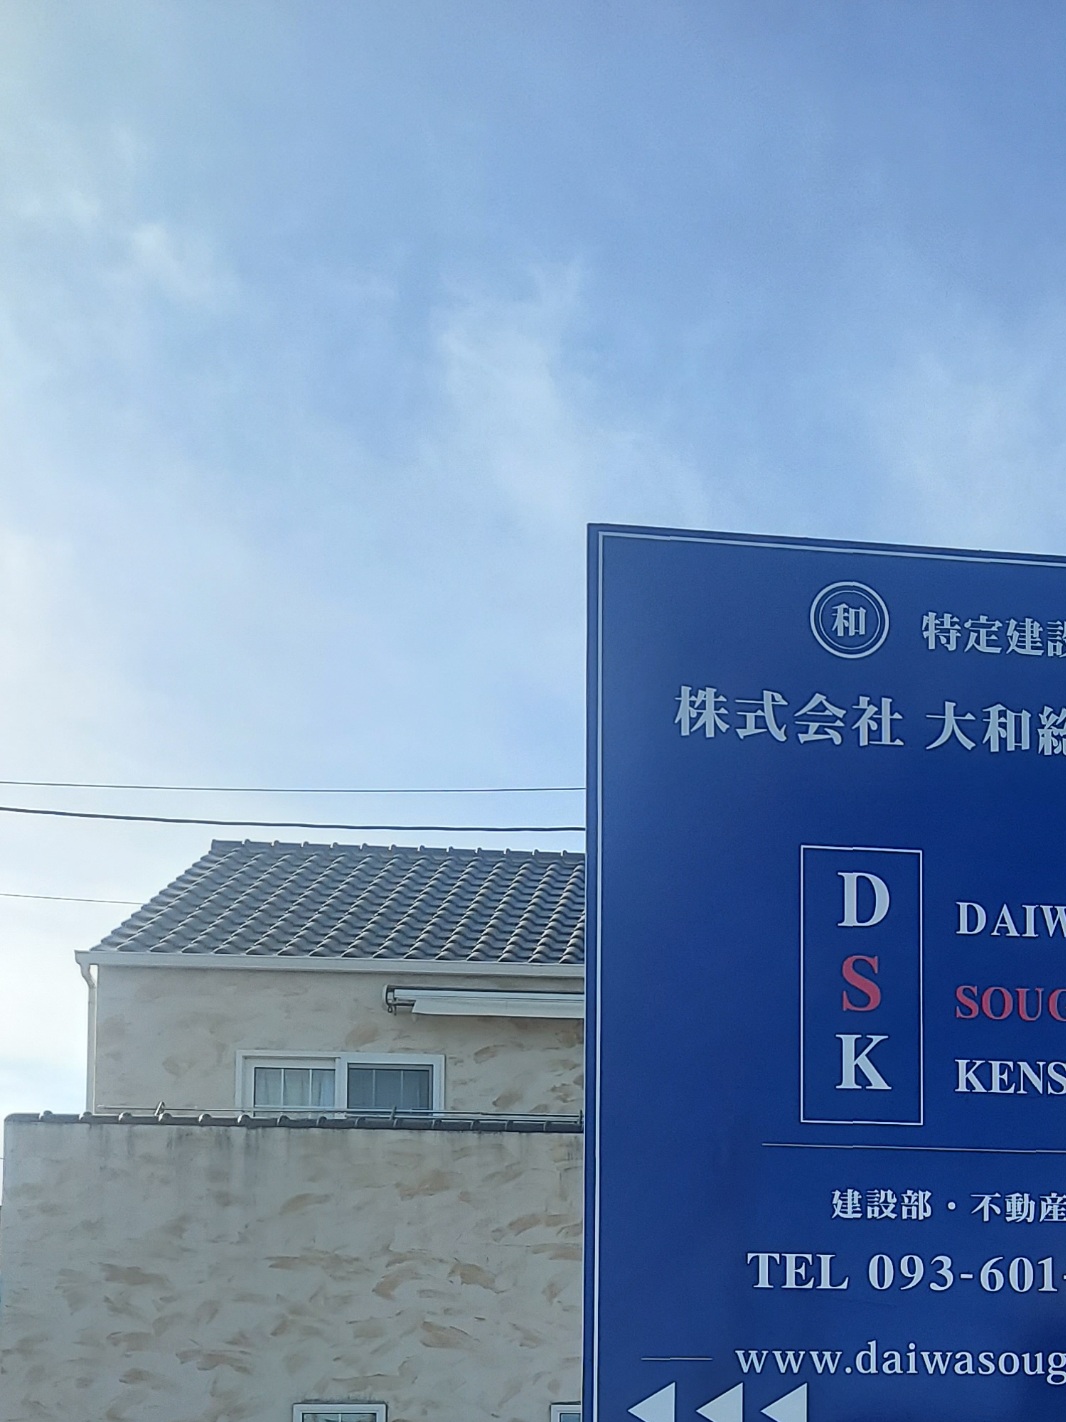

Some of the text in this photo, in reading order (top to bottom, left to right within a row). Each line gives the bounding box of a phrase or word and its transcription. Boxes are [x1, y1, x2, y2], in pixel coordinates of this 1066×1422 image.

[832, 603, 867, 637] 和
[674, 685, 904, 747] 株式会社
[747, 1253, 849, 1290] TEL
